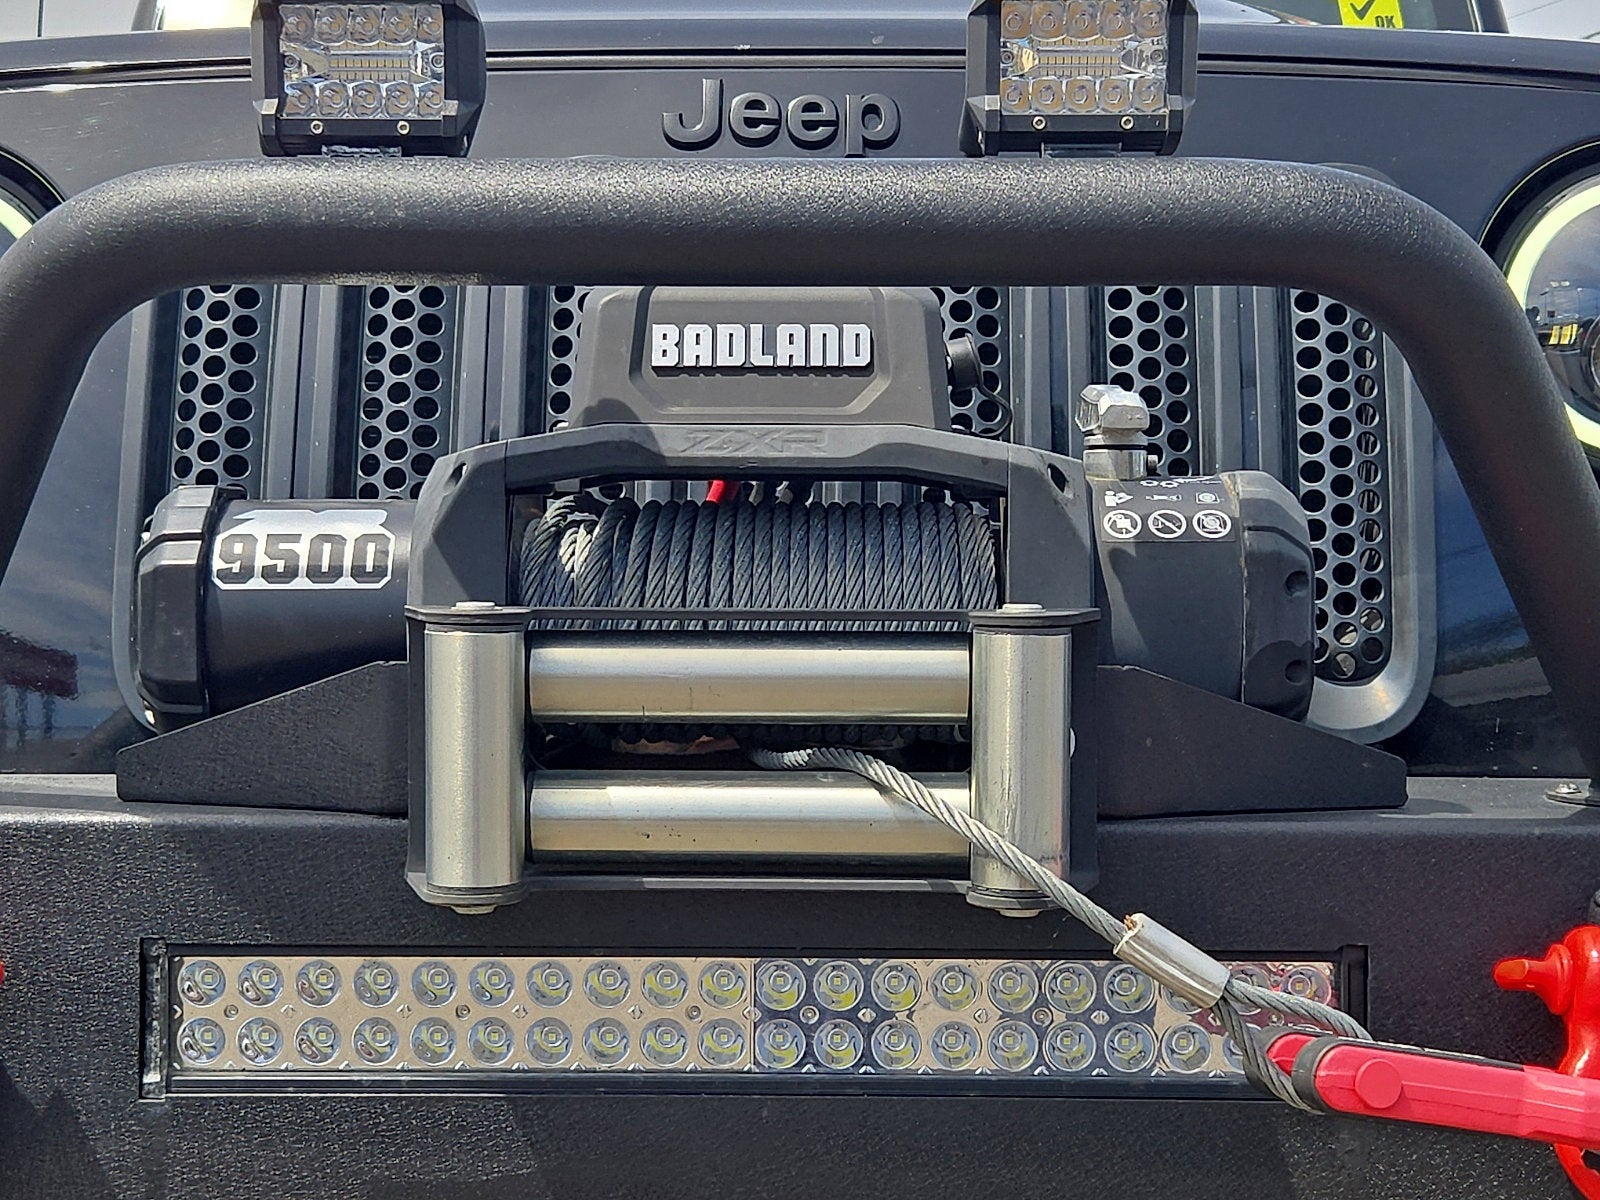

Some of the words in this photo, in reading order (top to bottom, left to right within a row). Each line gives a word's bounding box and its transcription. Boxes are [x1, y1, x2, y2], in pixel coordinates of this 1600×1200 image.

[1375, 15, 1396, 28] OK
[661, 78, 901, 158] Jeep
[651, 323, 873, 370] BADLAND
[215, 533, 391, 584] 9500
